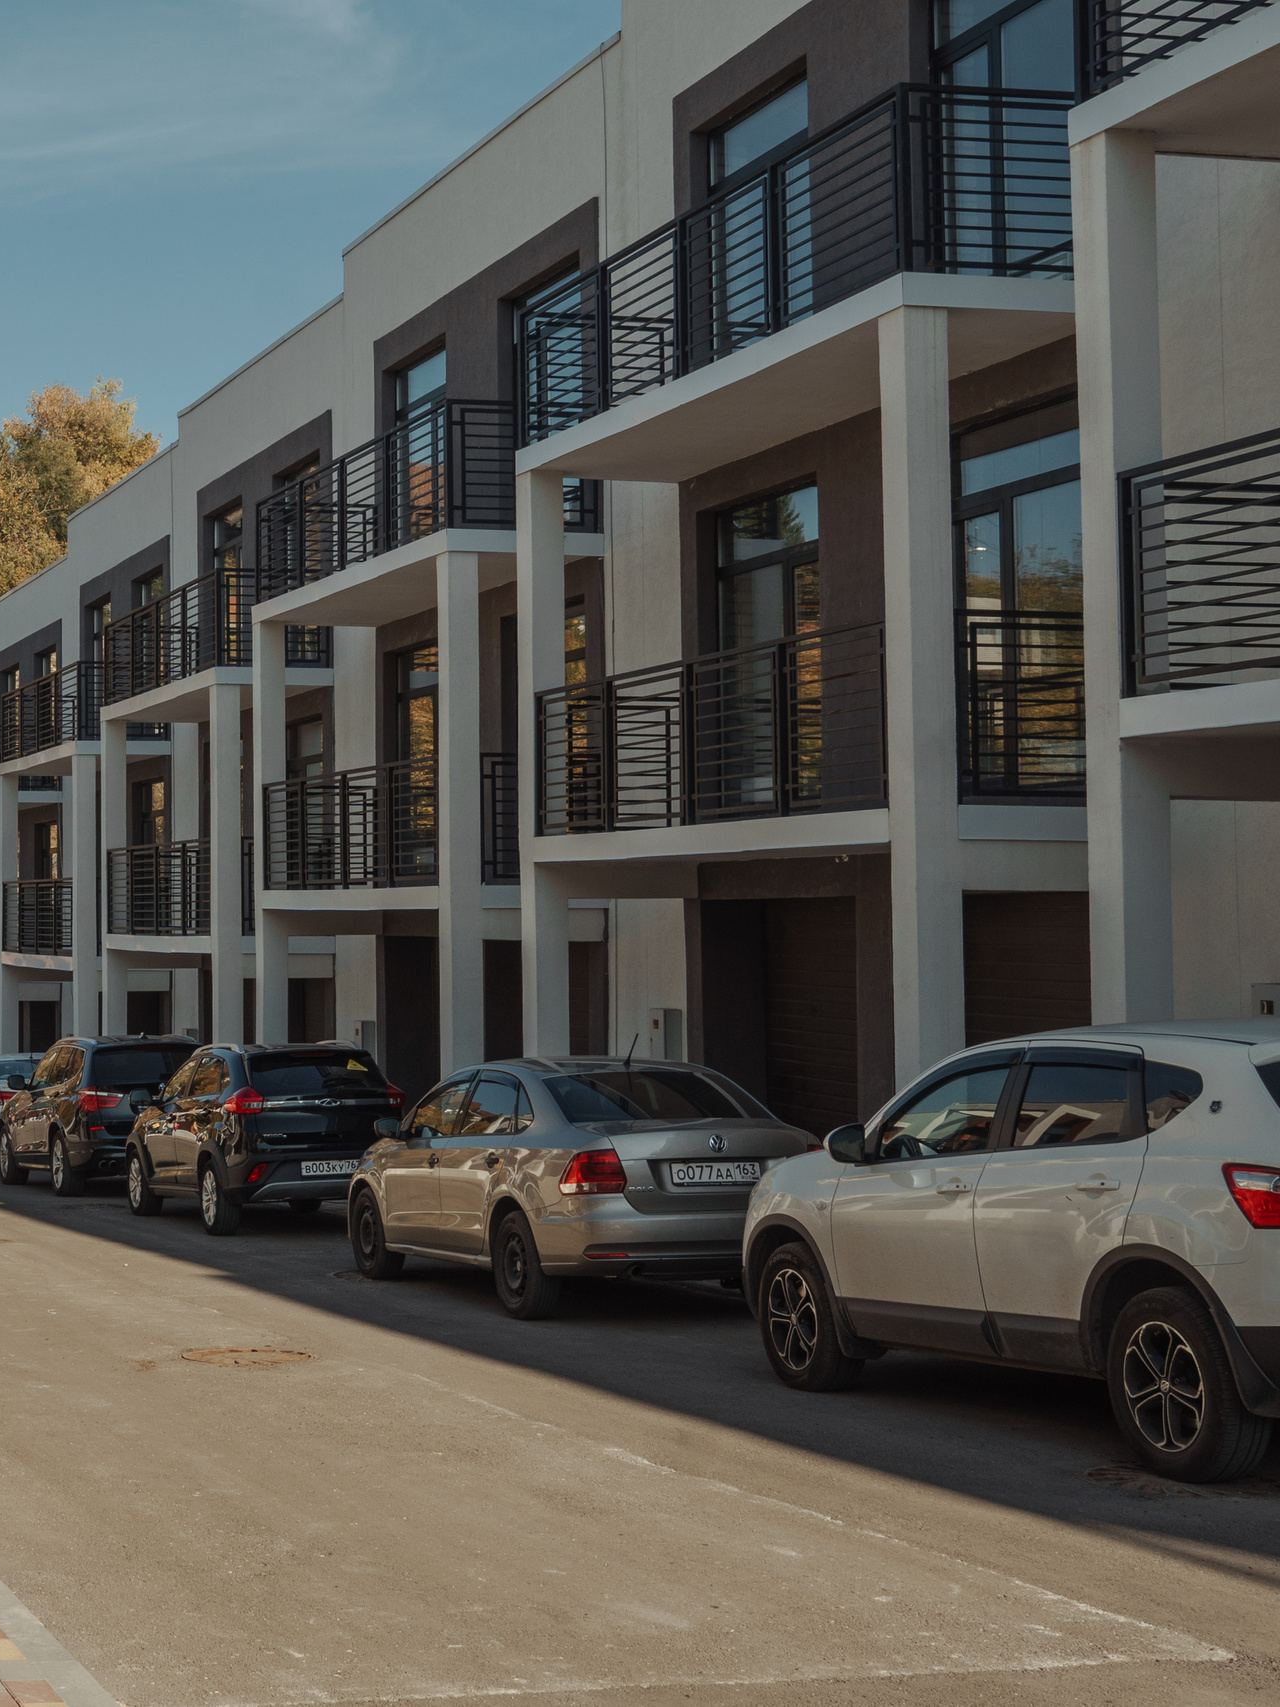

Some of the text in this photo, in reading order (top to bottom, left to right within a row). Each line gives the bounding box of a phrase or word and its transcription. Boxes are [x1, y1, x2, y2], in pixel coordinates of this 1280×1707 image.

[305, 1162, 344, 1174] В003КУ
[676, 1164, 756, 1180] О077АА 163
